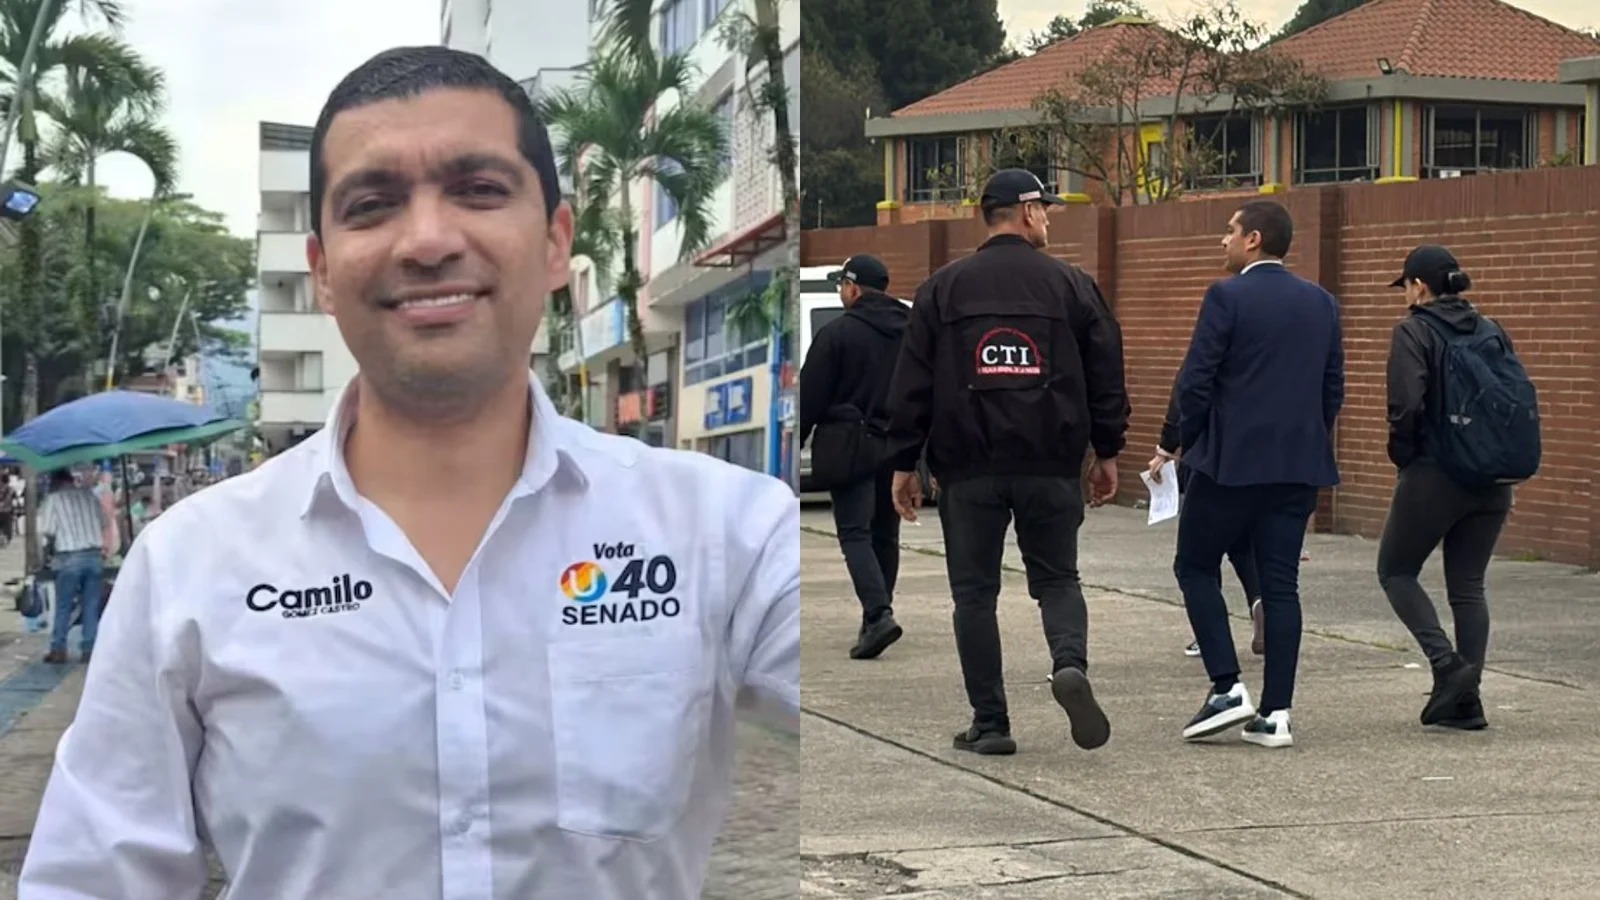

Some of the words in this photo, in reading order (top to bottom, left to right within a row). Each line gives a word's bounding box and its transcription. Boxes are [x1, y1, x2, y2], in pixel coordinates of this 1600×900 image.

[981, 344, 1030, 366] CTI
[593, 541, 635, 559] Vota
[610, 554, 677, 599] 40
[246, 573, 373, 612] Camilo
[320, 602, 360, 615] CASTRO
[562, 596, 680, 625] SENADO
